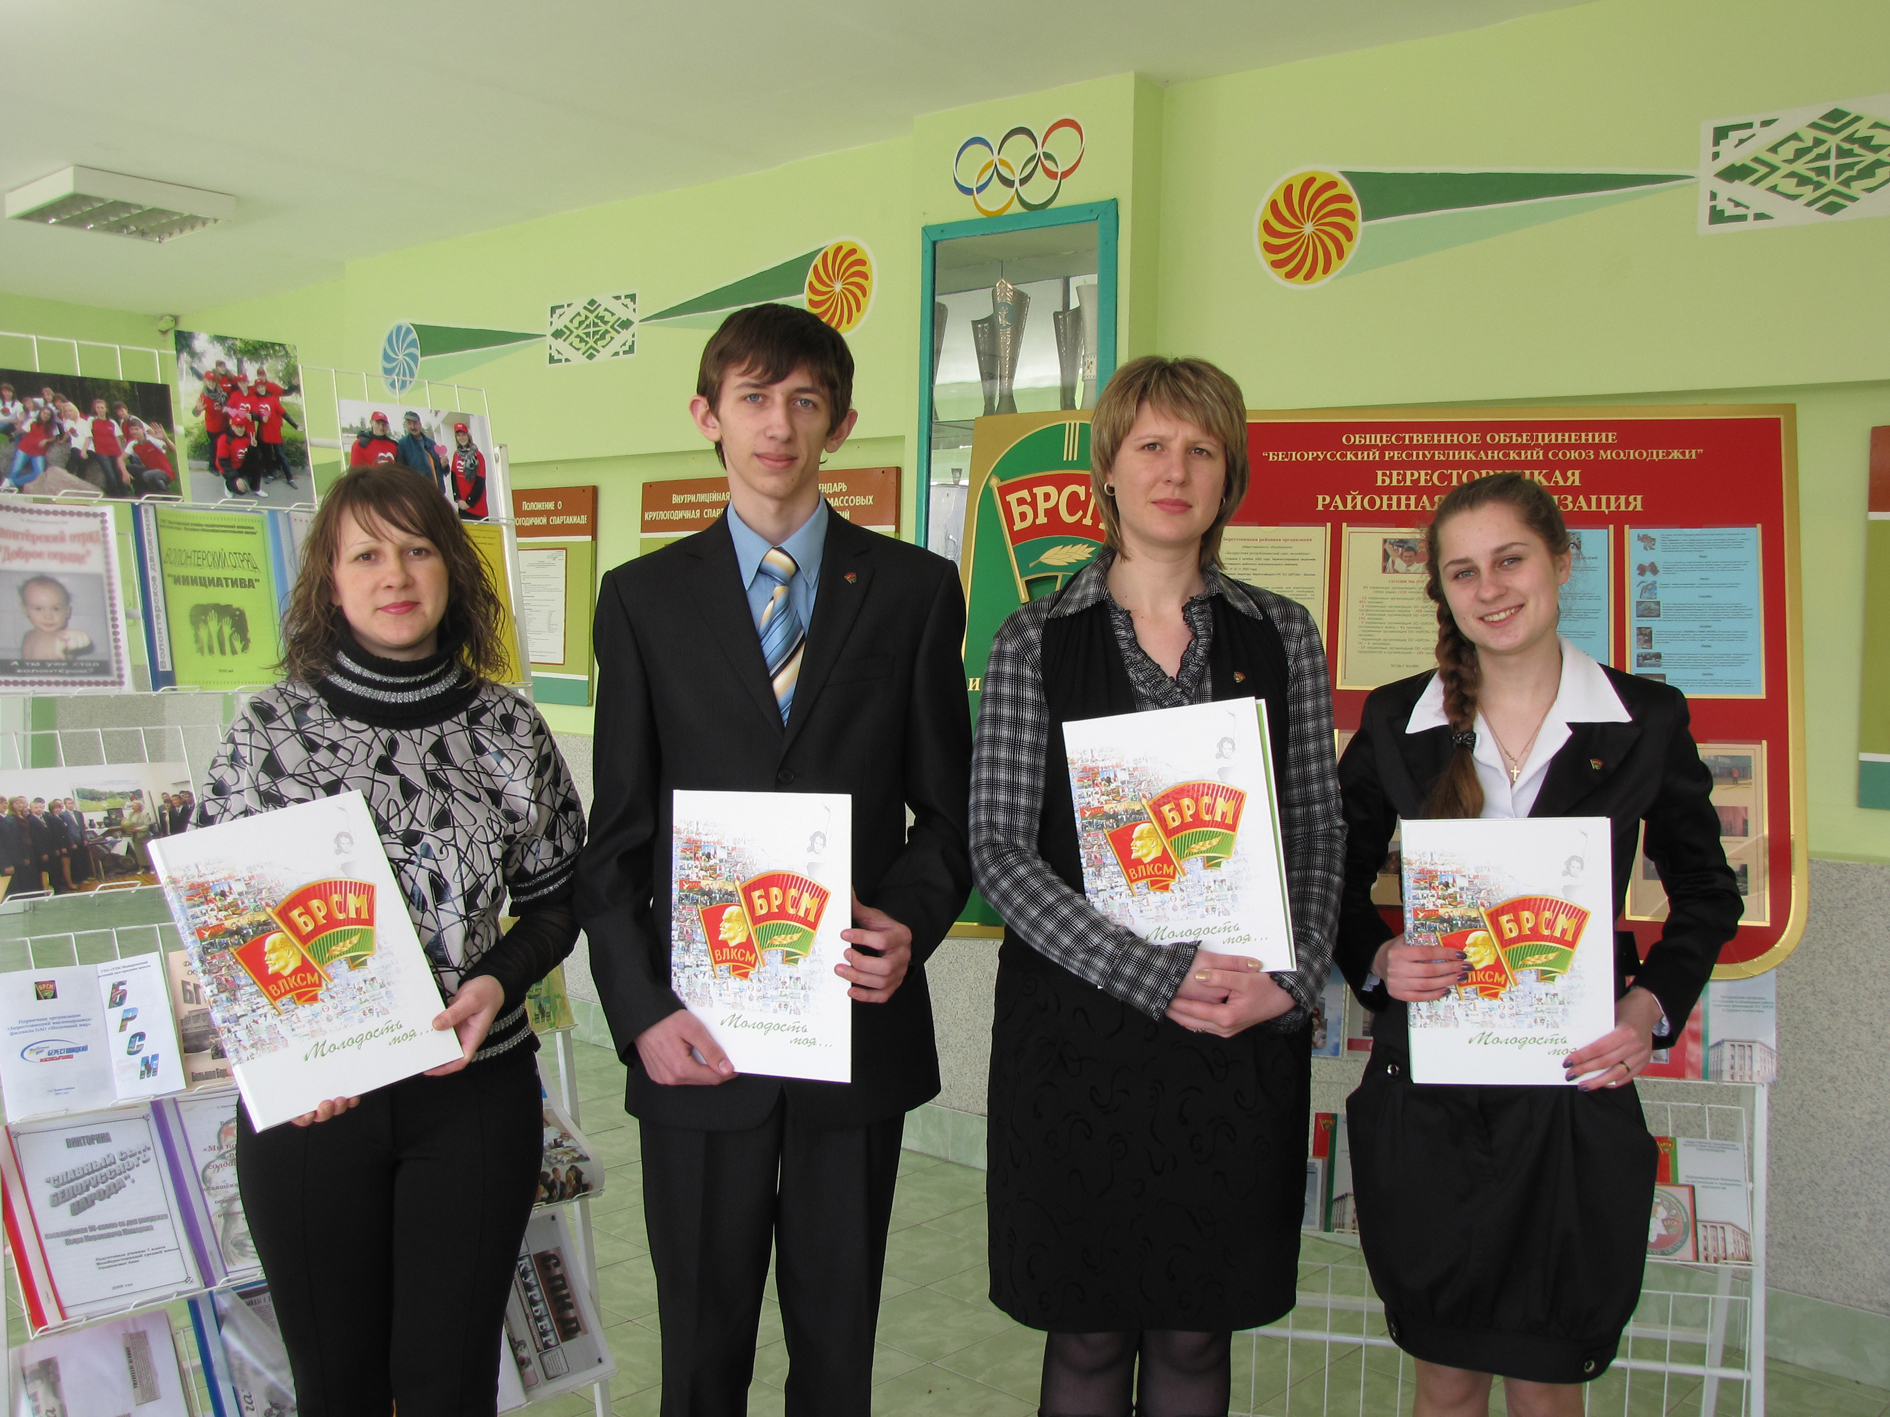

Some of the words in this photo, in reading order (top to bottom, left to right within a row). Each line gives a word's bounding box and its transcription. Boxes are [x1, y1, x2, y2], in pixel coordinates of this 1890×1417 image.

[1342, 432, 1482, 446] ОБЩЕСТВЕННОЕ
[1486, 432, 1618, 446] ОБЪЕДИНЕНИЕ
[1384, 448, 1544, 462] РЕСПУБЛИКАНСКИЙ
[1548, 449, 1595, 461] СОЮЗ
[1375, 469, 1582, 487] БЕРЕСТОКАЯ
[672, 491, 731, 503] ВНУТРИЛИЦЕЙНАЯ
[818, 482, 848, 494] ЕНДАРЬ
[827, 495, 874, 507] МАССОВЫХ
[515, 515, 548, 526] ОГОДИЧНОЙ
[549, 514, 588, 525] СПАРТАКИАДЕ
[644, 508, 700, 520] КРУГЛОГОДИЧНАЯ
[703, 507, 725, 518] СПАРТ
[167, 573, 261, 589] "ИНИЦИАТИВА"
[1159, 795, 1237, 830] БРСМ
[1129, 862, 1175, 880] ВЛКСМ
[288, 892, 370, 936] БРСМ
[750, 886, 820, 924] БРСМ
[1144, 920, 1241, 942] Молодость
[1497, 910, 1578, 942] БРСМ
[714, 948, 756, 965] ВЛКСМ
[268, 971, 320, 997] ВЛКСМ
[1461, 970, 1506, 985] ЛКСМ
[719, 1012, 809, 1036] Молодость
[303, 1019, 404, 1062] Молодость
[1468, 1031, 1568, 1050] Молодость
[65, 1131, 113, 1149] ВИКТОРИНА
[517, 1256, 556, 1347] КУРЬЕР
